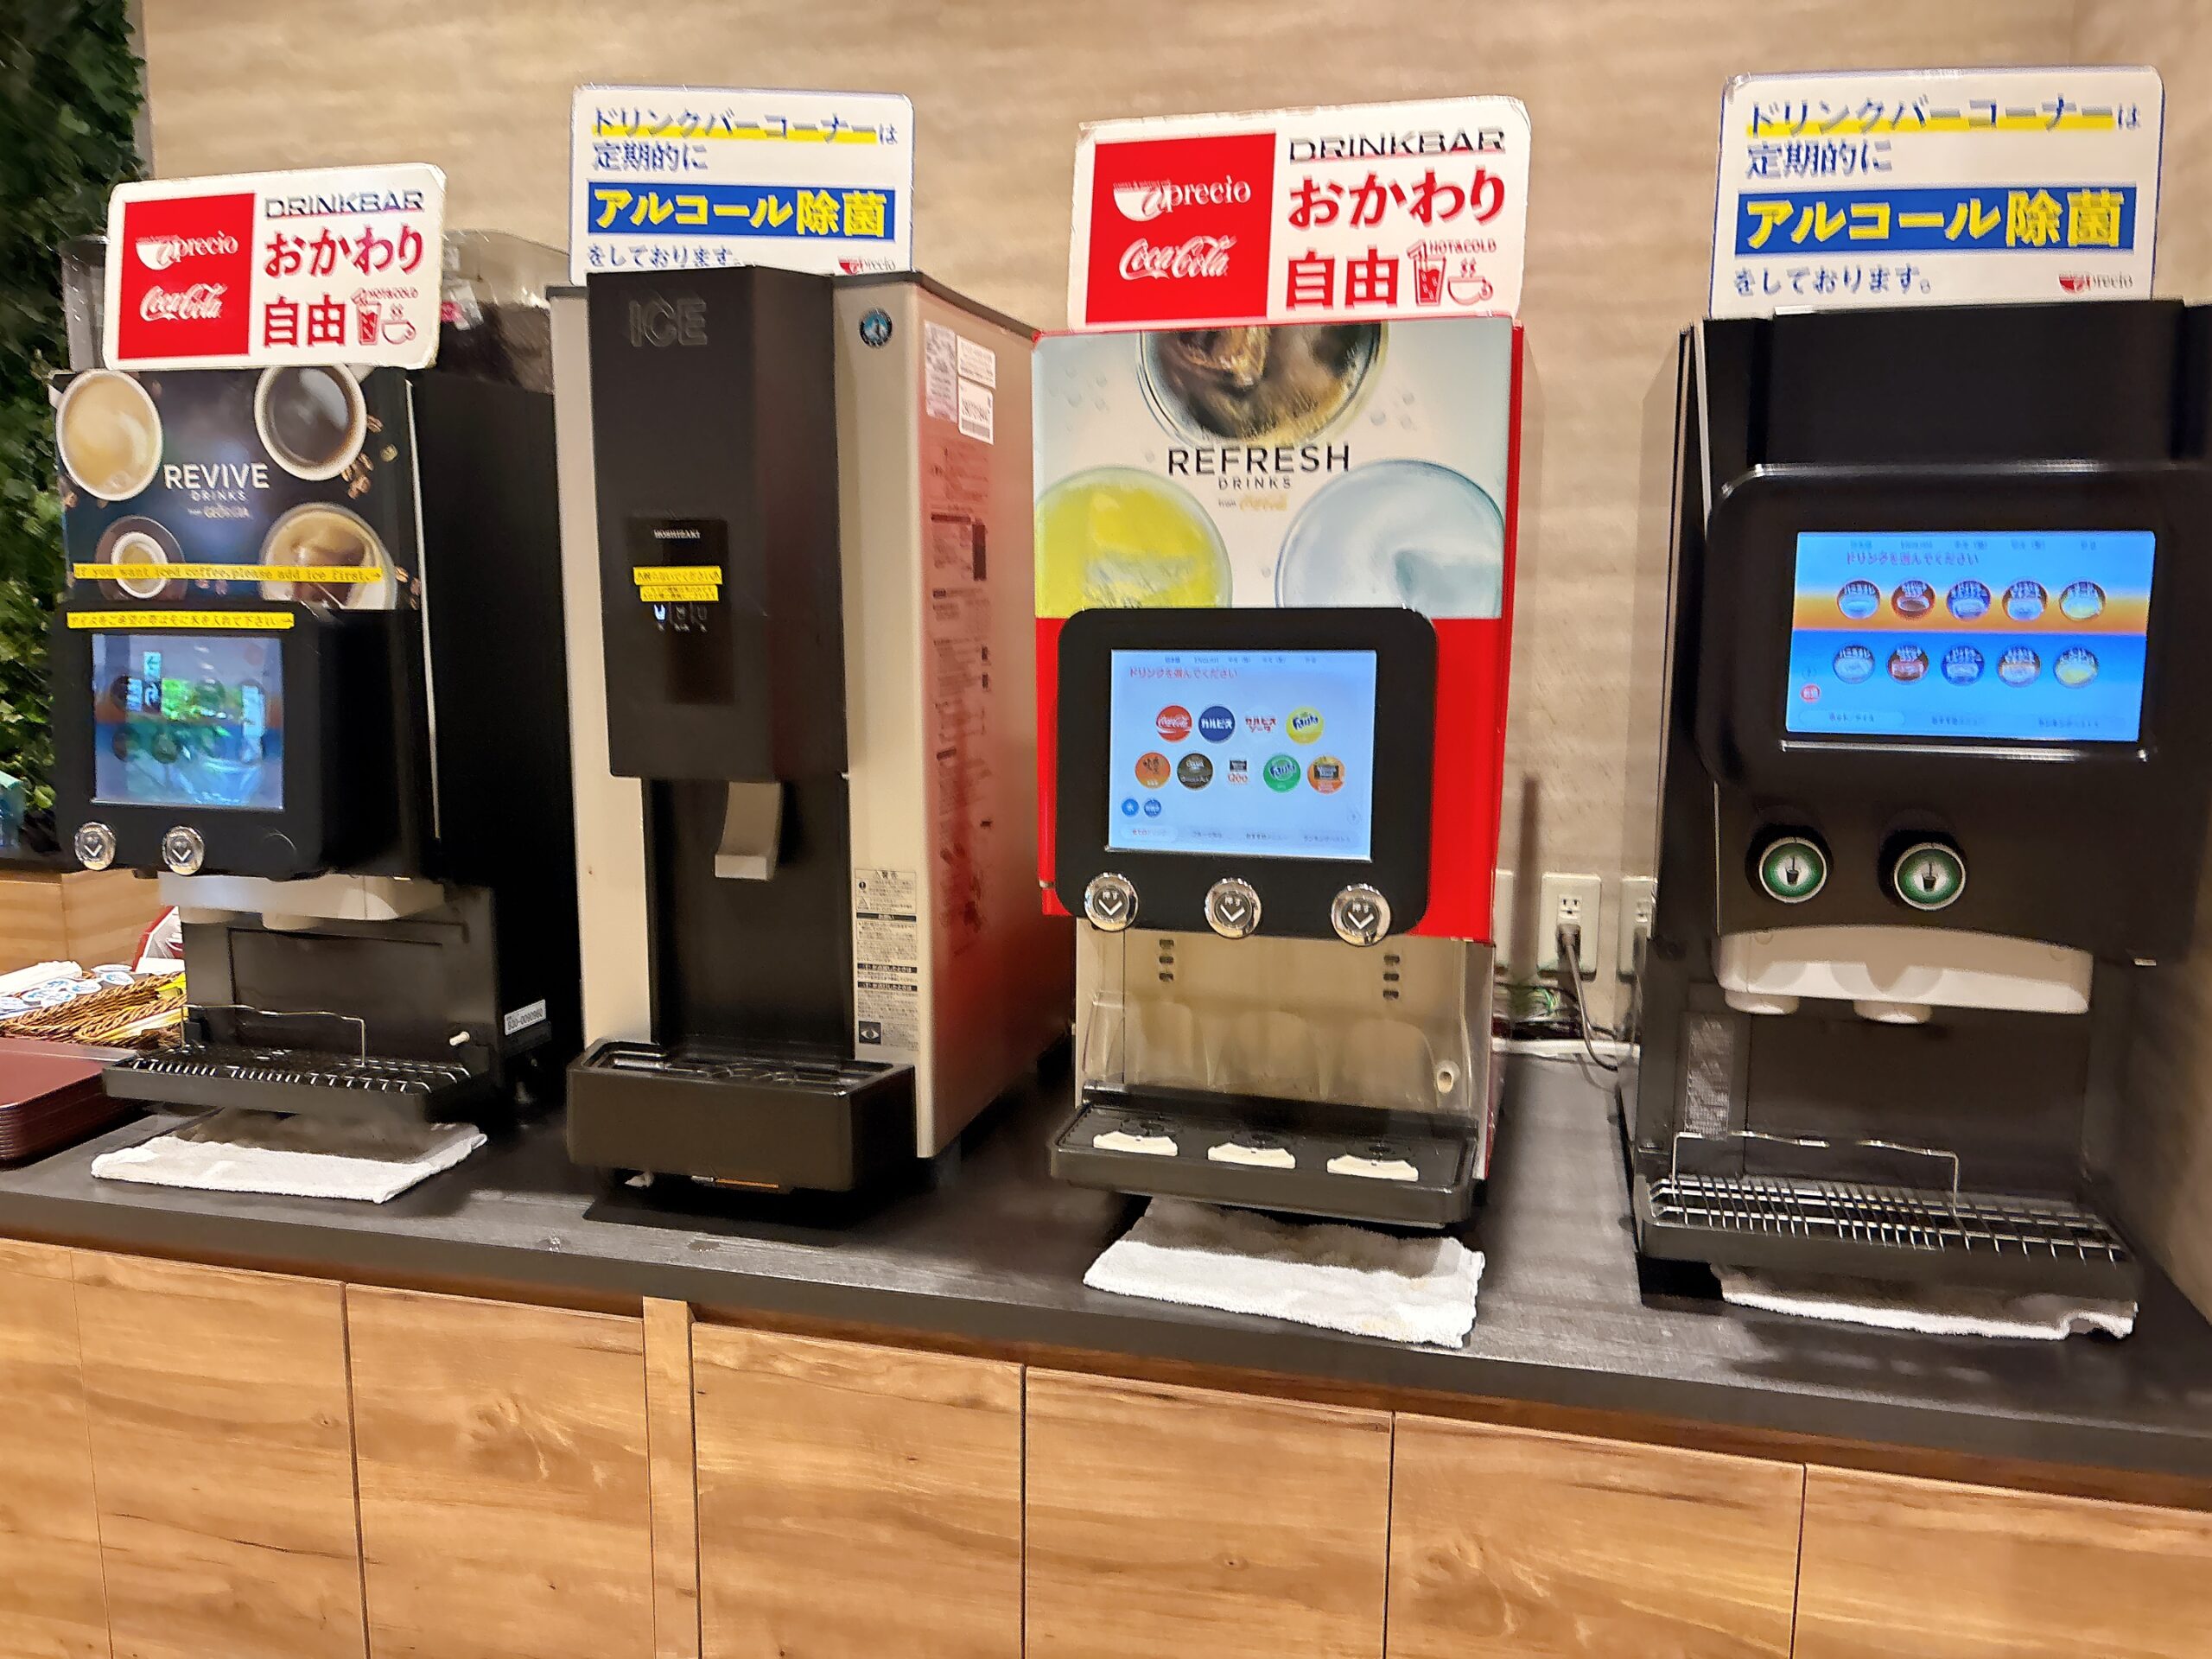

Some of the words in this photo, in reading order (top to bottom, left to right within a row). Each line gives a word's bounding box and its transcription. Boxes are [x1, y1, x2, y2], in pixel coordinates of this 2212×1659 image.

[592, 105, 898, 145] ドリンクバーコーナーは
[1751, 93, 2141, 137] ドリンクバーコーナーは
[592, 142, 709, 173] 定期的に
[1288, 127, 1506, 163] DRINKBAR
[1745, 140, 1892, 180] 定期的に
[265, 190, 425, 219] DRINKBAR
[594, 188, 887, 238] アルコール除菌
[1287, 165, 1506, 230] おかわり
[1746, 188, 2124, 249] アルコール除菌
[264, 222, 425, 276] おかわり
[1286, 246, 1400, 311] 自由
[1733, 264, 1932, 296] をしております。
[264, 294, 346, 348] 自由
[628, 297, 709, 346] ICE
[163, 462, 270, 490] REVIVE
[1168, 442, 1349, 475] REFRESH
[190, 490, 249, 502] DRINKS
[1218, 477, 1292, 490] DRINKS
